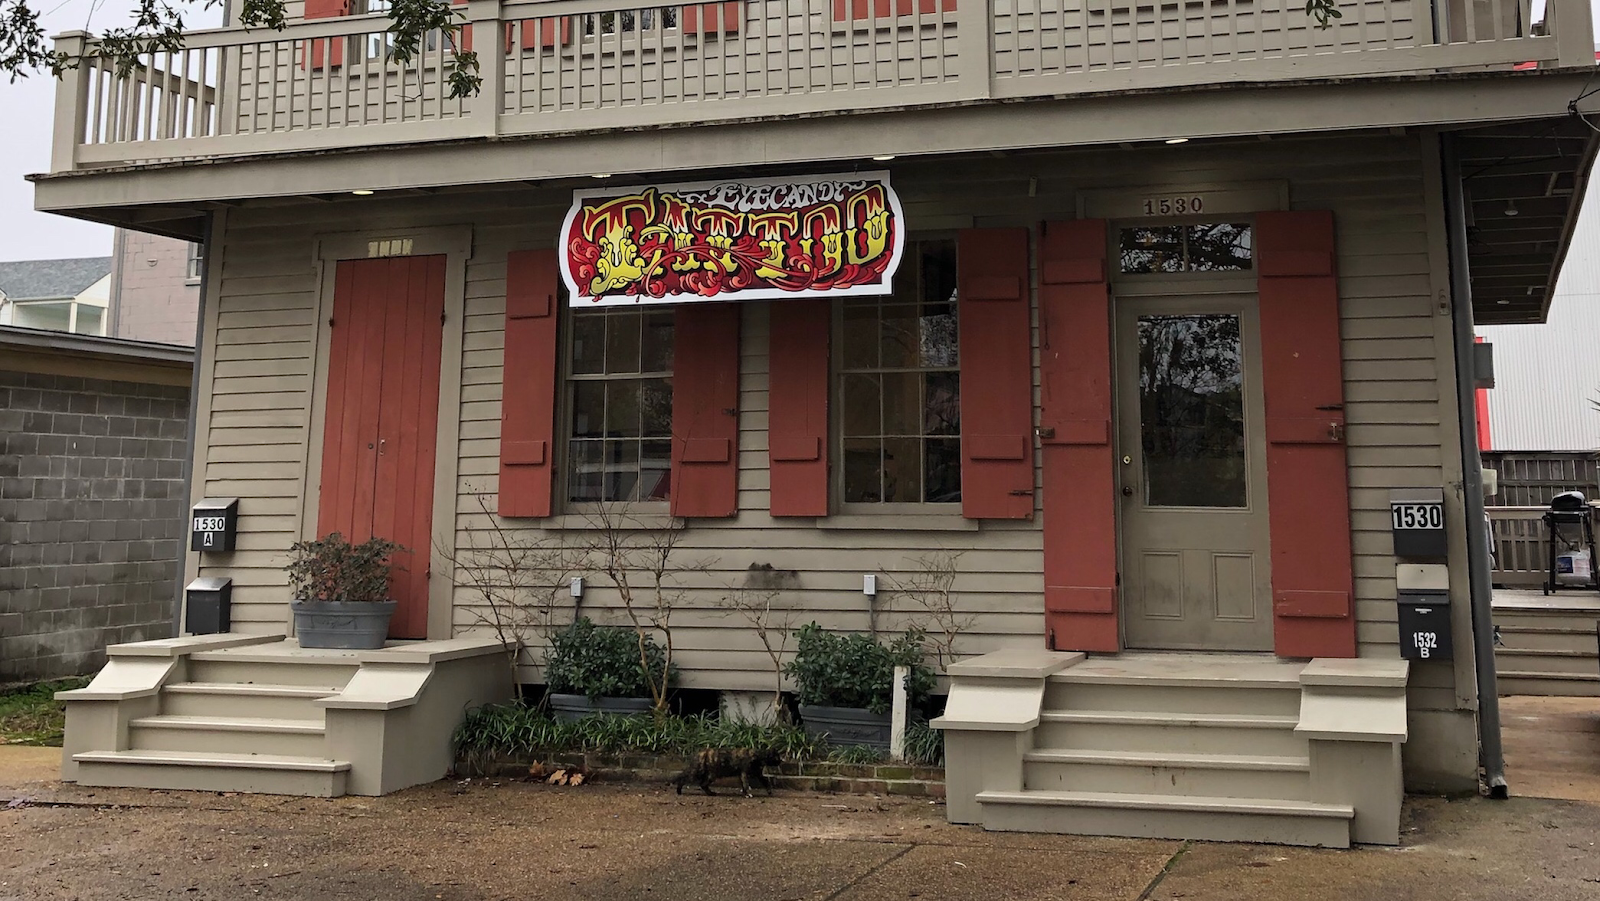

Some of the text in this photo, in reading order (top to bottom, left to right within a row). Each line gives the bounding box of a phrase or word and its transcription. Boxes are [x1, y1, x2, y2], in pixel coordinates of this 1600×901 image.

[686, 180, 864, 212] EYECANDY
[1144, 197, 1203, 215] 1530
[583, 185, 890, 295] TATTOO
[195, 518, 224, 530] 1530
[1393, 506, 1442, 528] 1530
[204, 533, 212, 545] A
[1413, 632, 1437, 648] 1532
[1420, 647, 1430, 658] B
